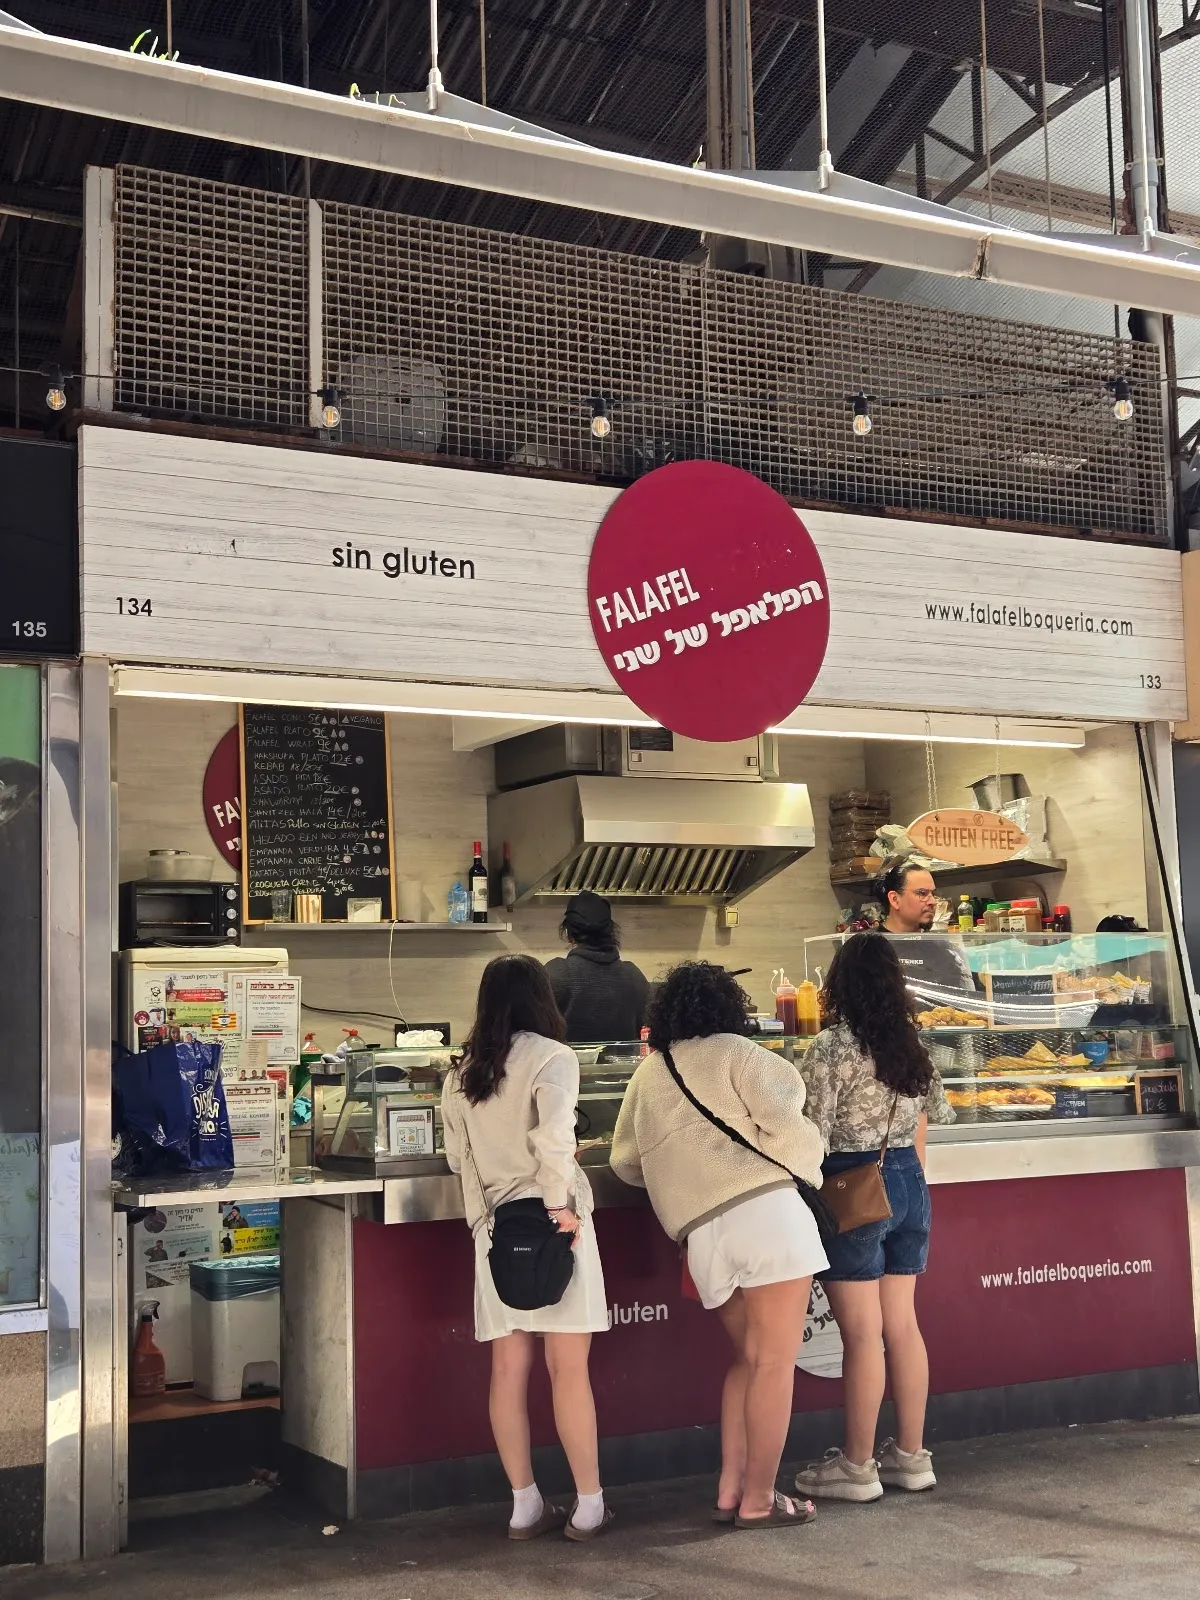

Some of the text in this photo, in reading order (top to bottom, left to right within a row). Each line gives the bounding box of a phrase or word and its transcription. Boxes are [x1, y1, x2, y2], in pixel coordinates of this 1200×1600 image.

[331, 541, 476, 580] sin gluten
[115, 596, 153, 617] 134
[595, 567, 701, 633] FALAFEL
[613, 580, 825, 672] הפלאפל של שני
[925, 602, 1134, 636] www.falafelboqueria.com
[11, 620, 47, 638] 135
[1139, 674, 1162, 690] 133
[349, 714, 383, 725] VEGANO
[247, 737, 281, 748] FALAFEL
[254, 761, 285, 772] KEBAB
[253, 773, 289, 785] ASADO
[253, 785, 291, 796] ASADO
[252, 832, 296, 845] HELADO
[925, 825, 1016, 851] GLUTEN FREE
[249, 848, 293, 857] EMPANADA
[249, 857, 293, 868] EMPANADA
[980, 1258, 1153, 1289] www.falafelboqueria.com
